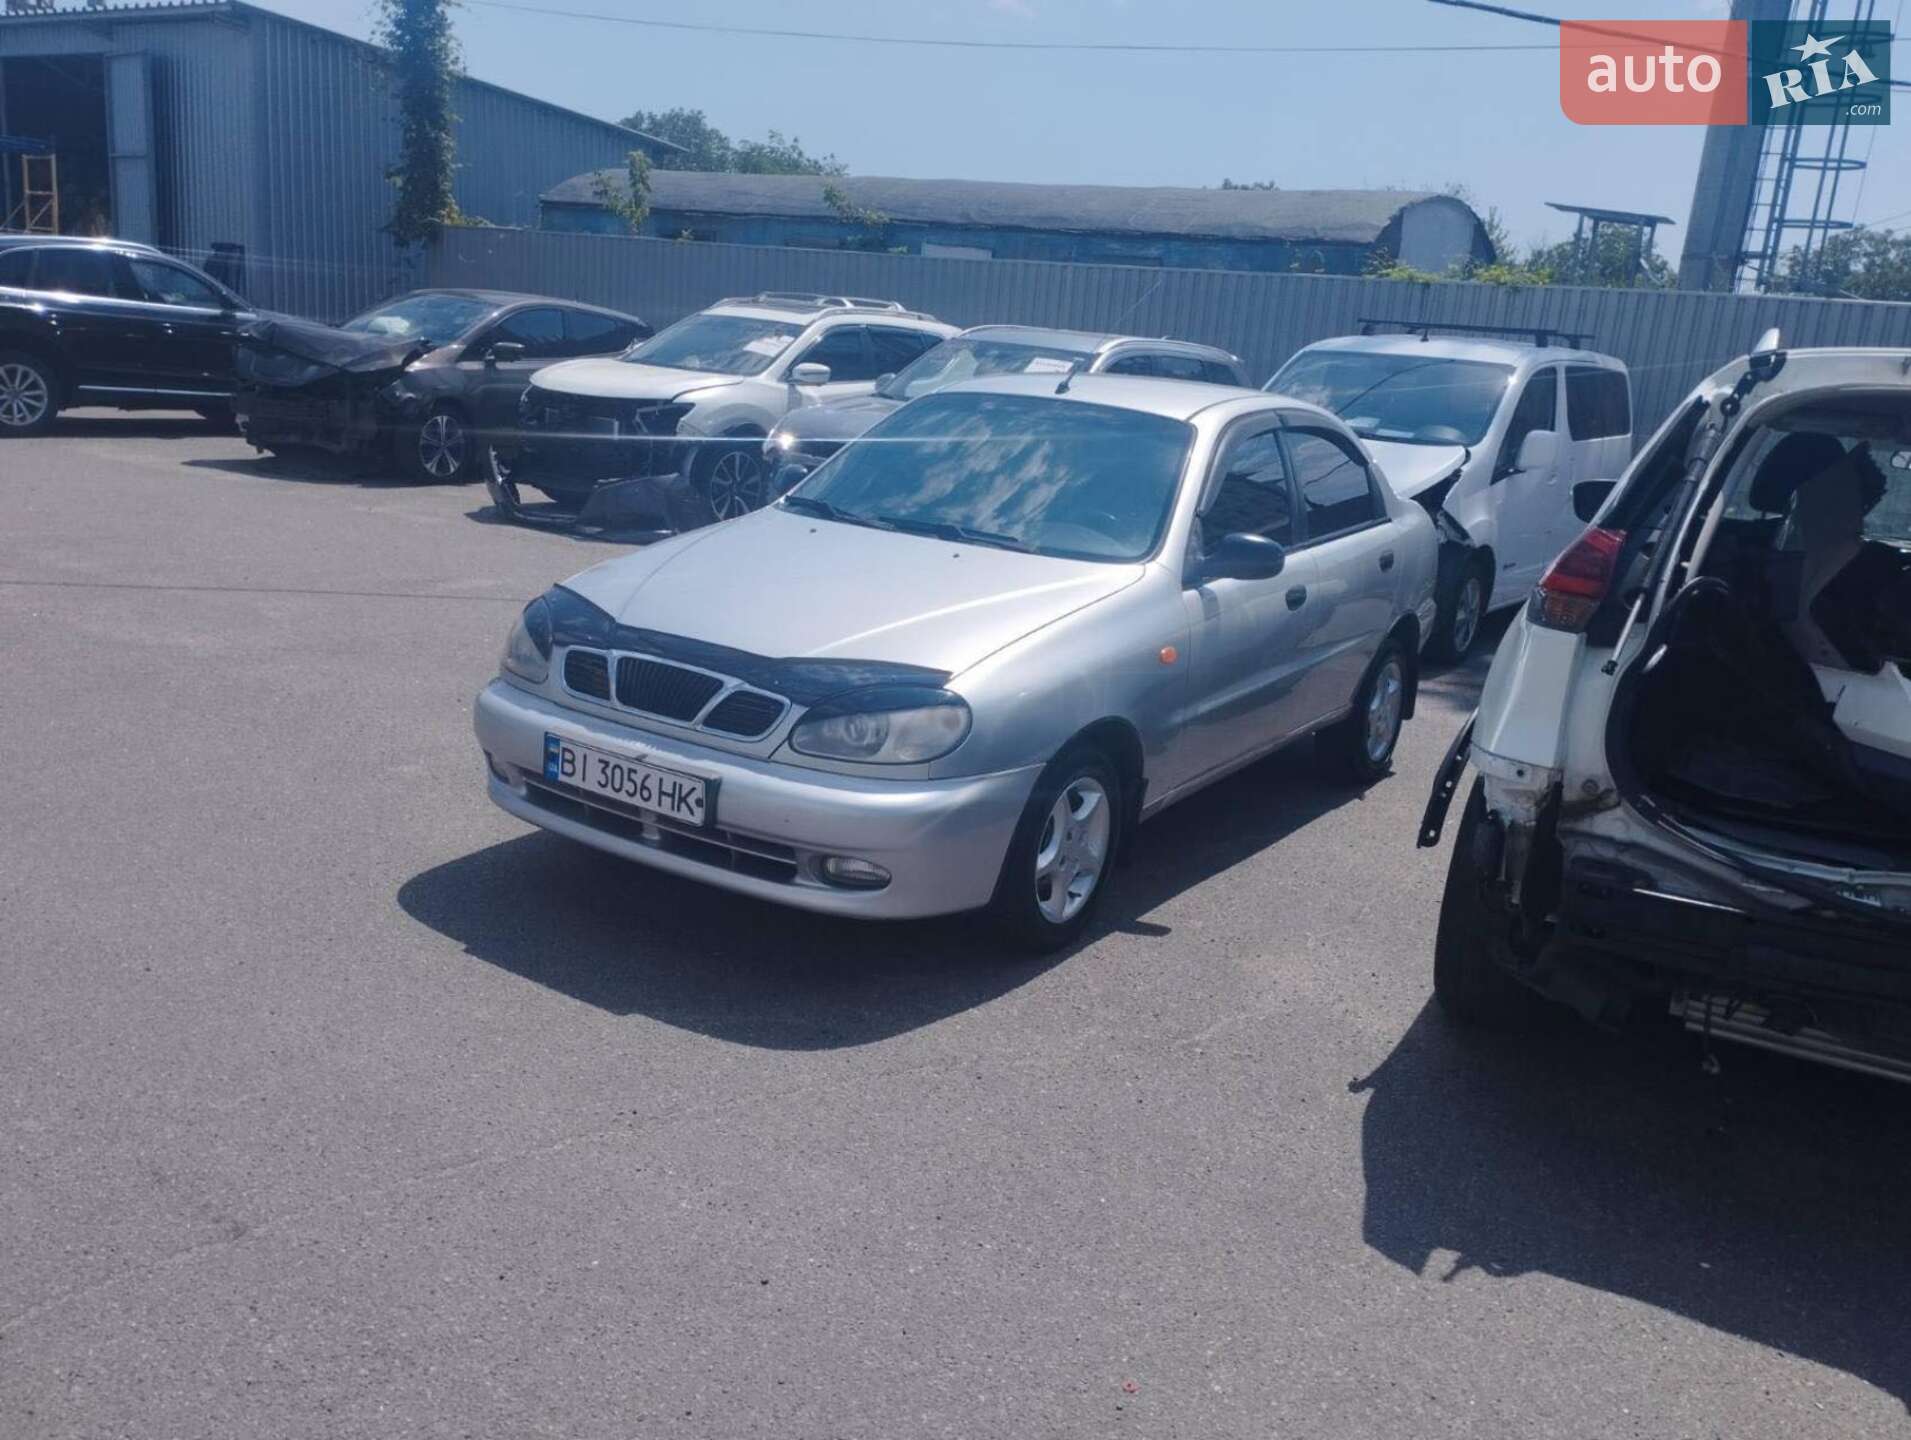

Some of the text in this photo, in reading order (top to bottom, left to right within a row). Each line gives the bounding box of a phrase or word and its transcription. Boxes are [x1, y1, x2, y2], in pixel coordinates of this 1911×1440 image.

[561, 747, 697, 817] BI 3056 HK
